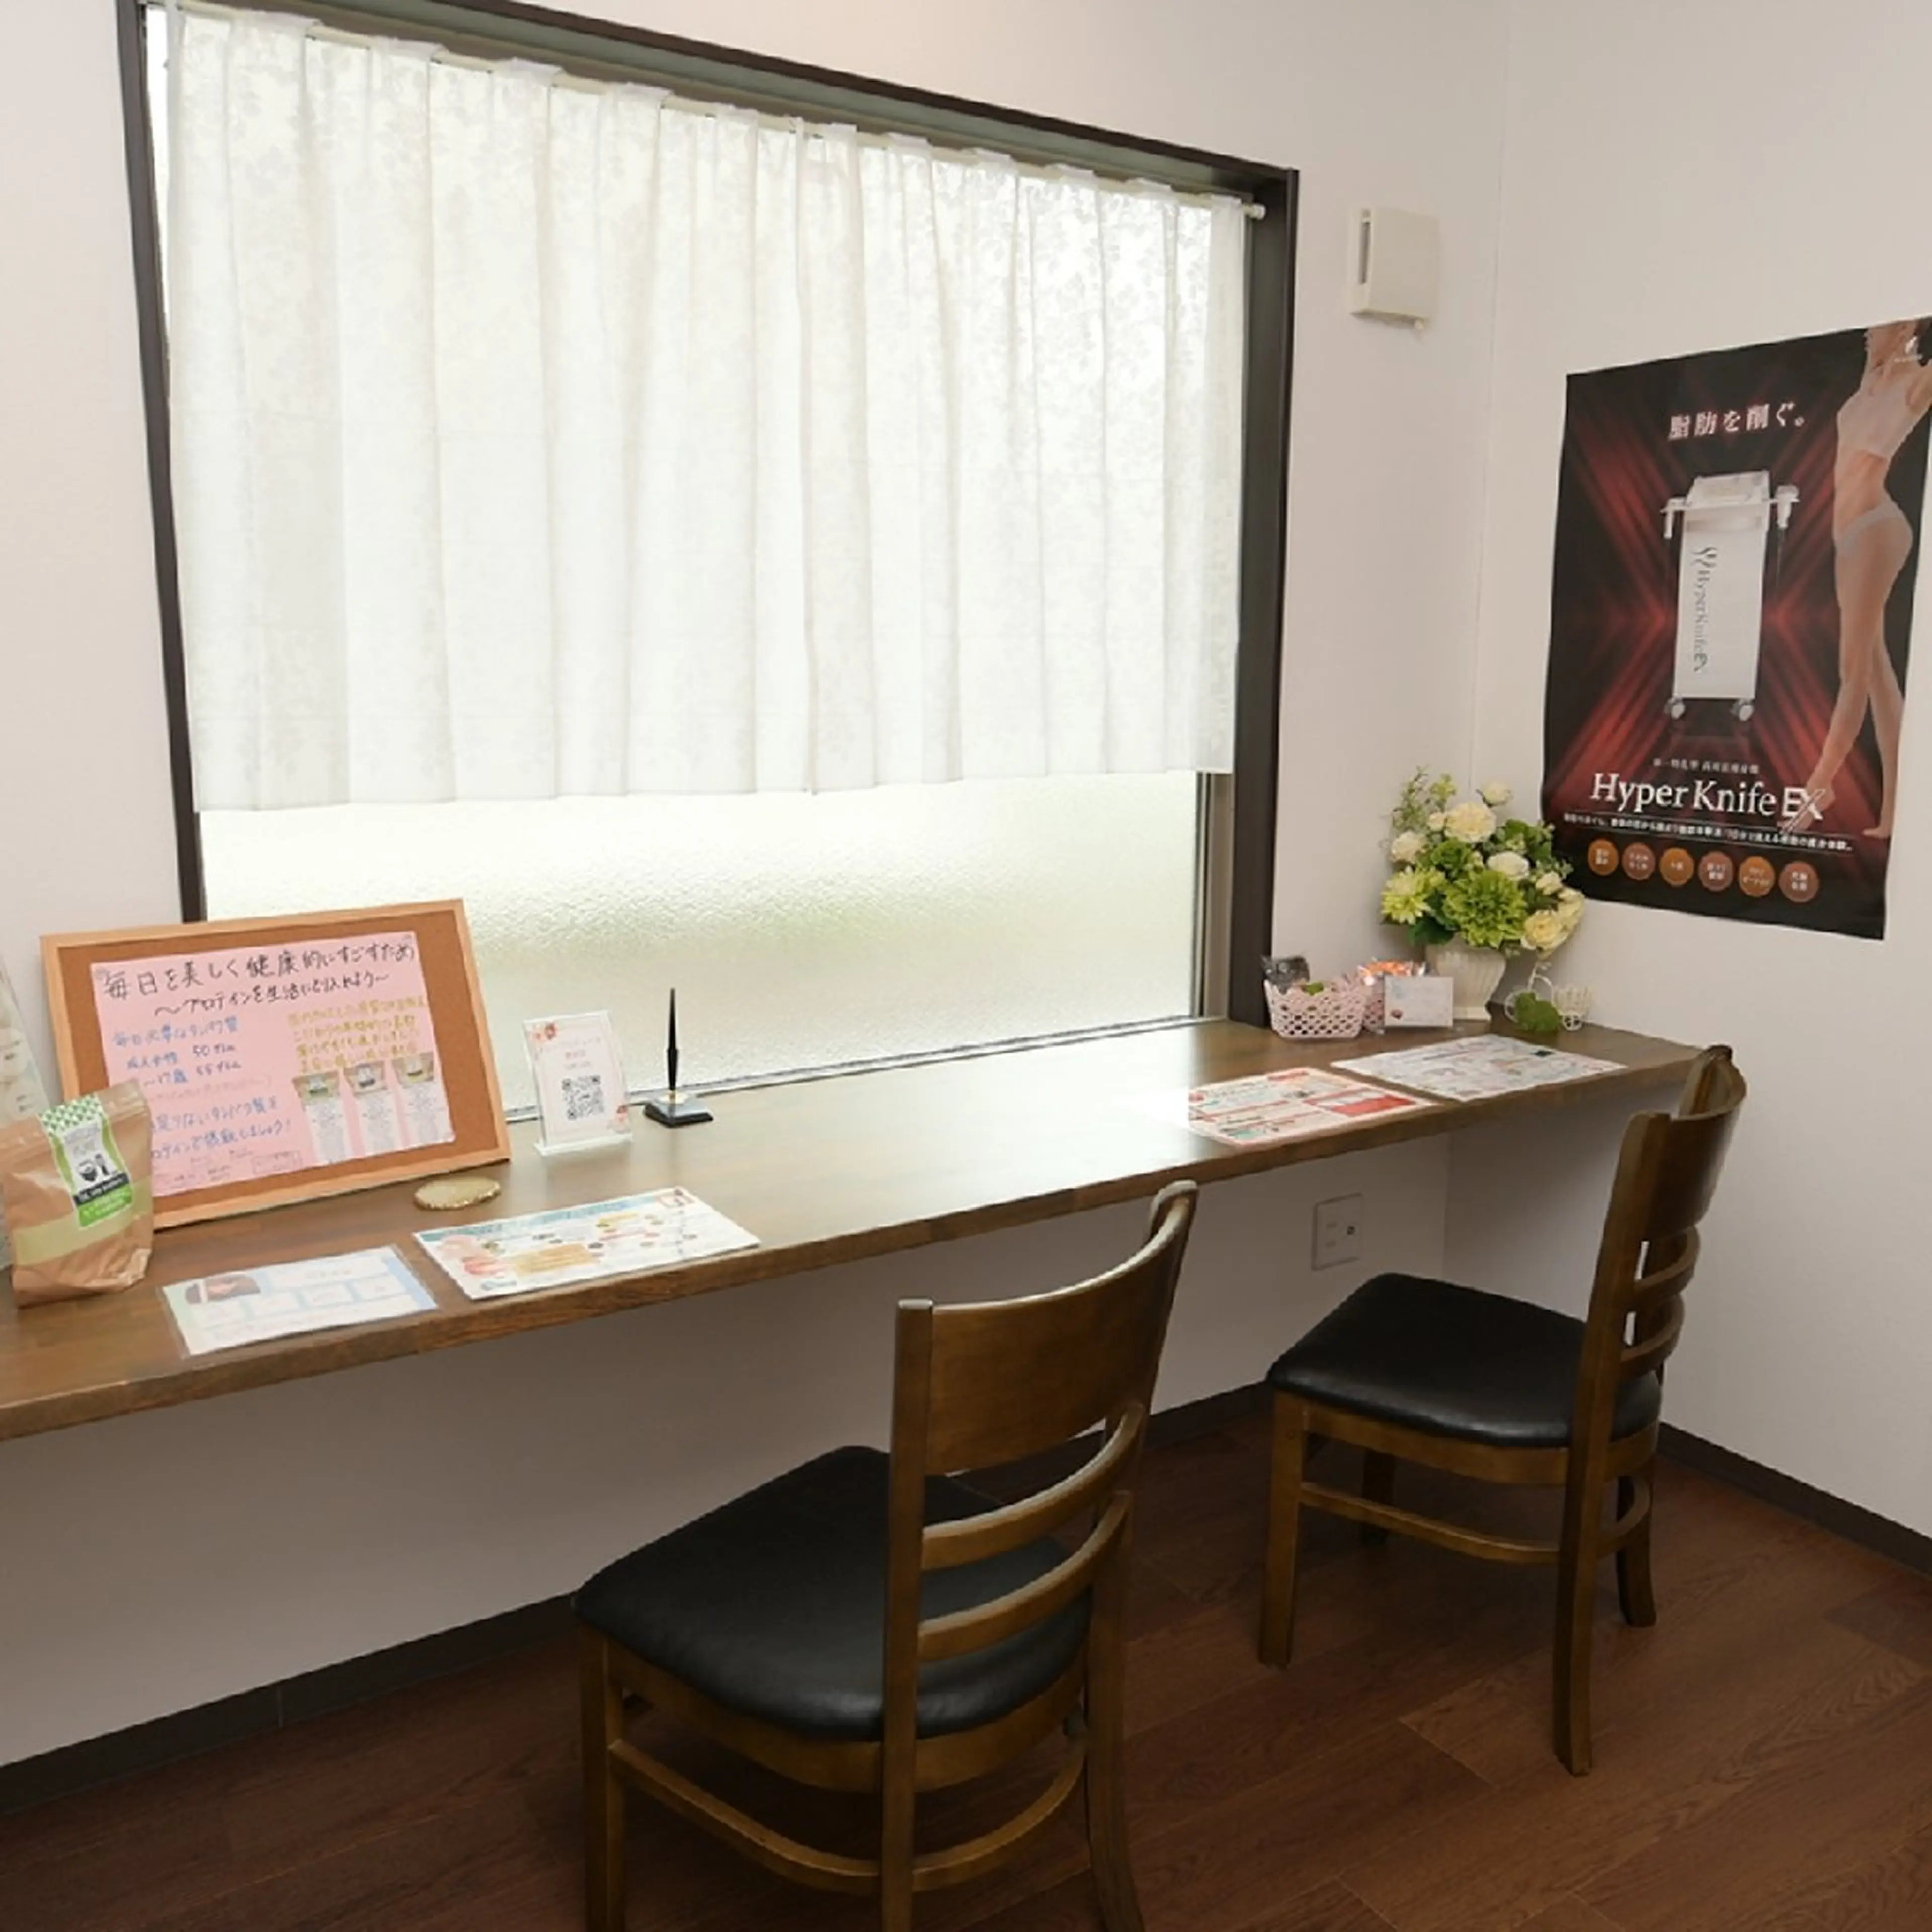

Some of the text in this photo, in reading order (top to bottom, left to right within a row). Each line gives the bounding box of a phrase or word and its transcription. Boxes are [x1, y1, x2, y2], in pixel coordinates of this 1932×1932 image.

[1668, 401, 1805, 441] 脂肪を削ぐ。
[1590, 772, 1824, 821] Hyper Knife EX
